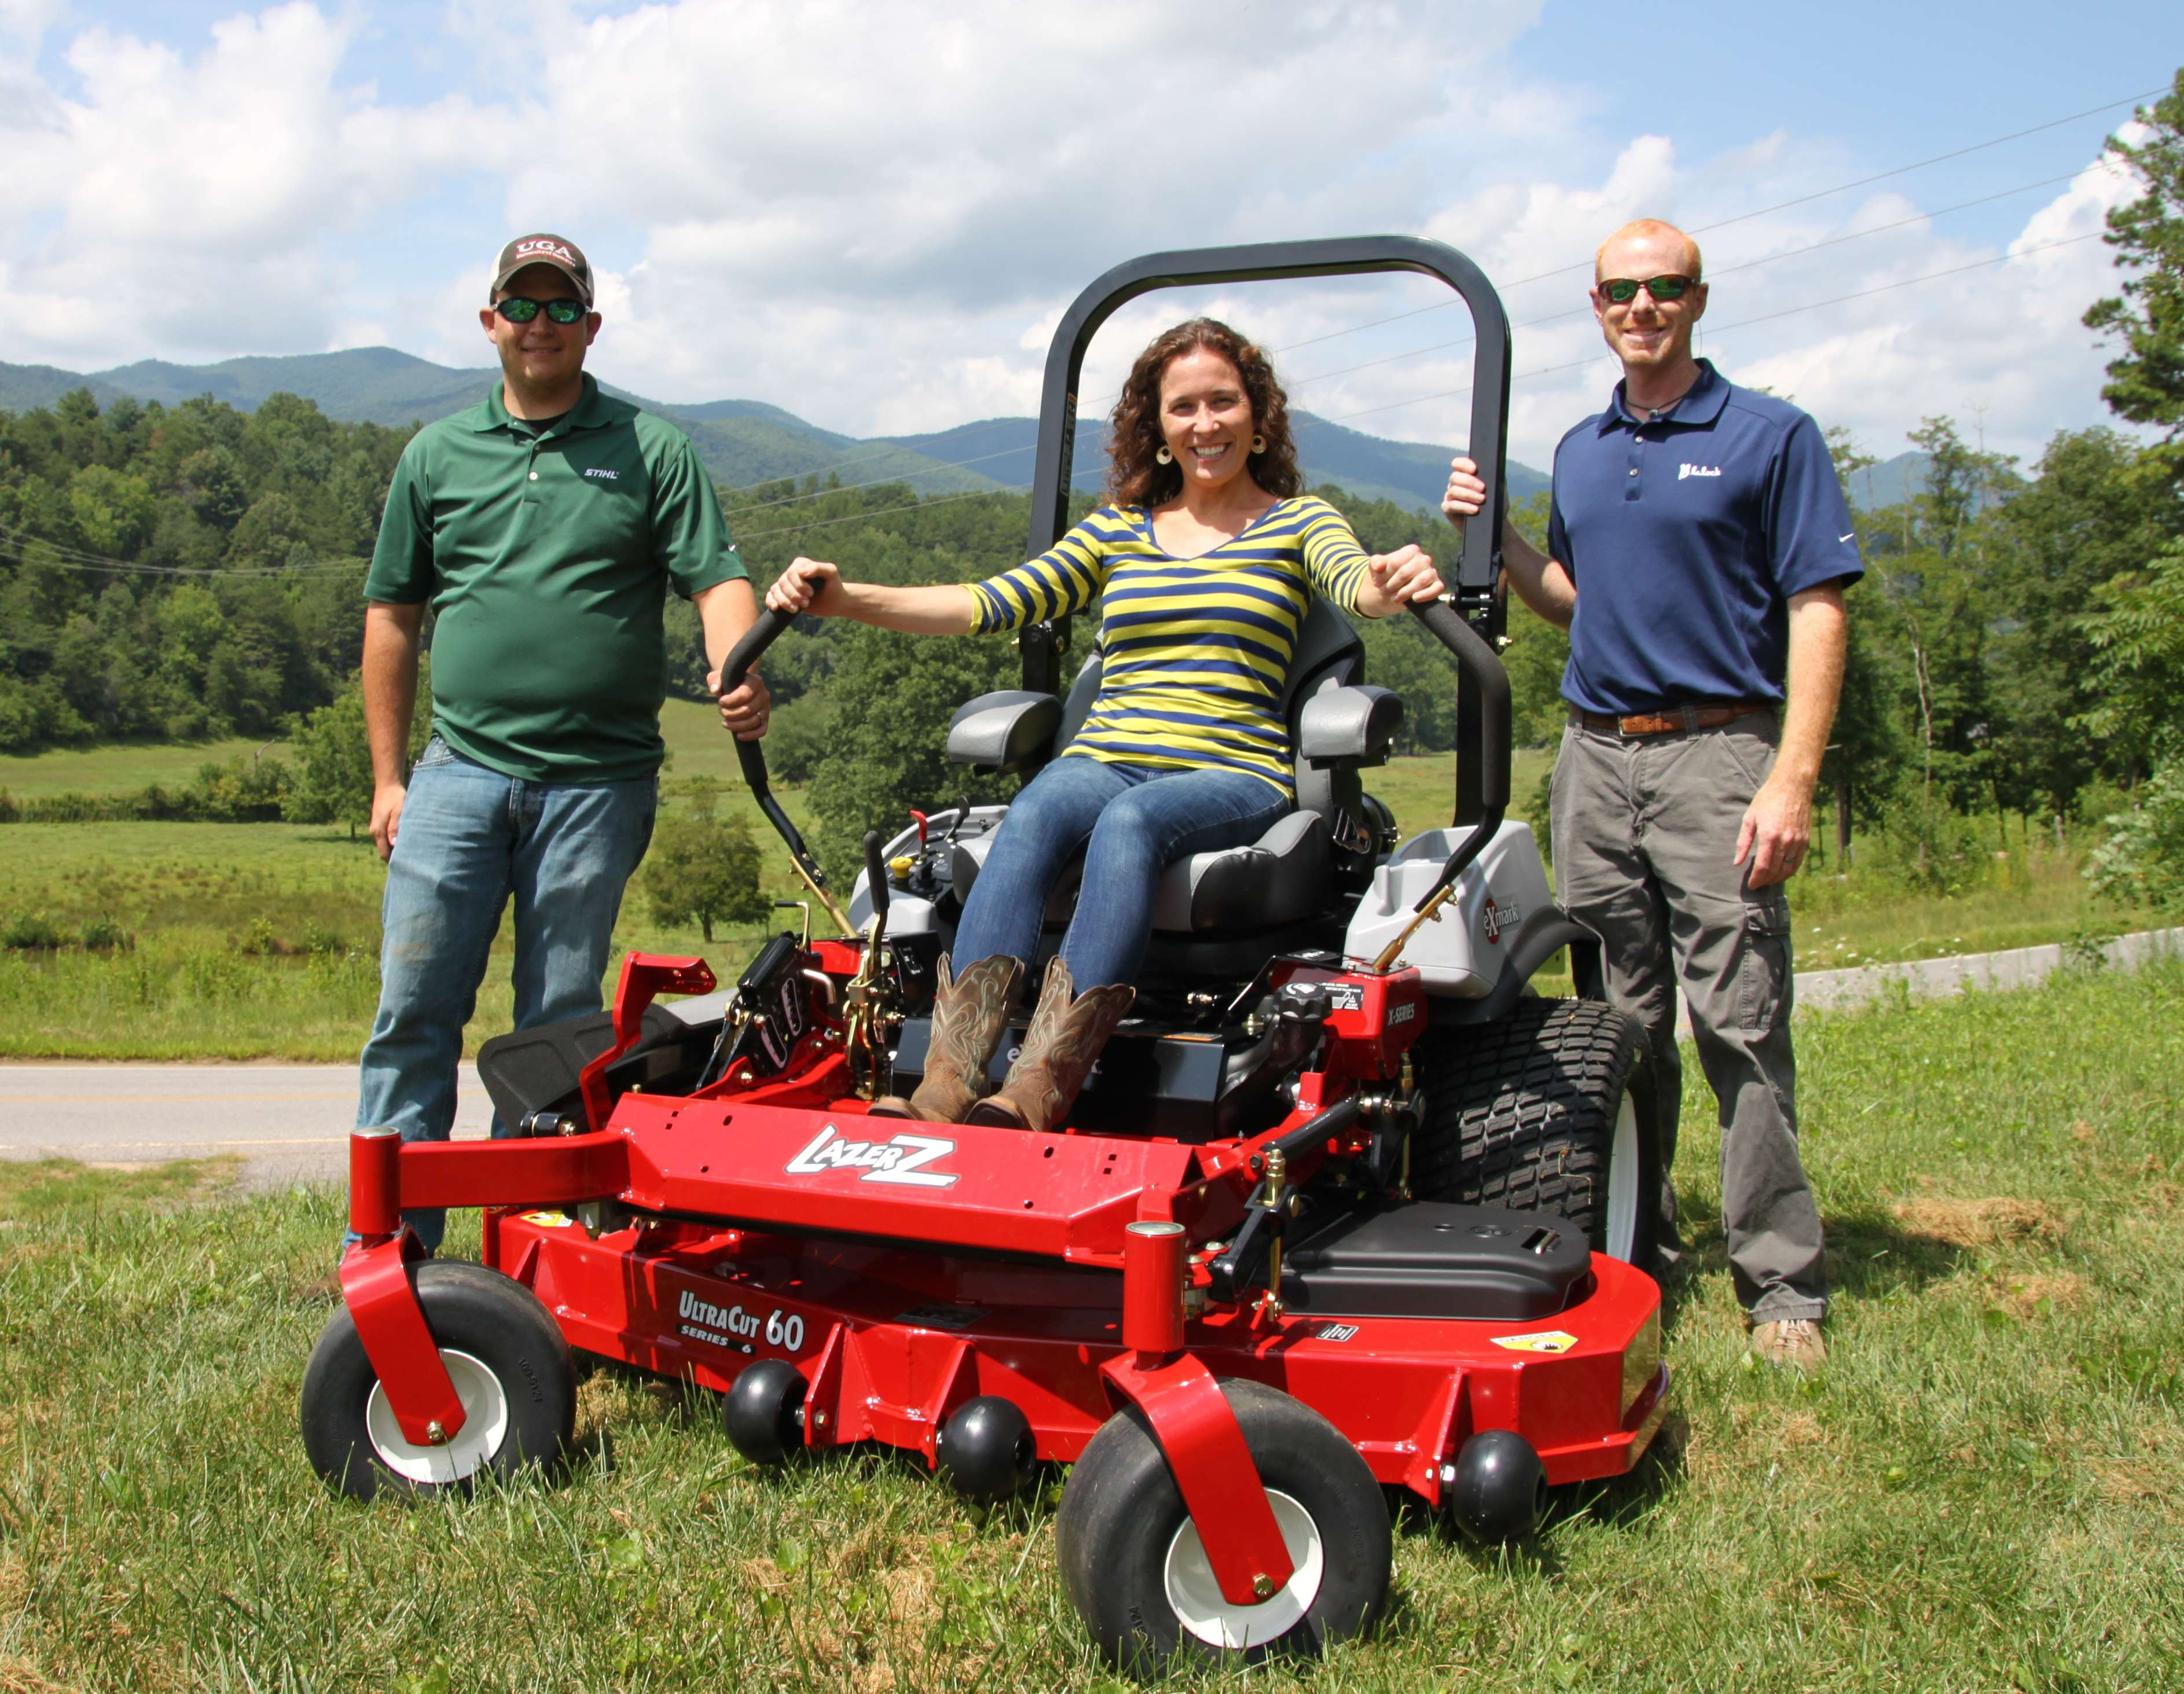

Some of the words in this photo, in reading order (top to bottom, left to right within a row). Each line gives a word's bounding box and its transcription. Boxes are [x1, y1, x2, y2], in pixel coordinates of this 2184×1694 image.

[516, 241, 574, 260] UGA
[584, 469, 618, 479] STIHL
[1388, 1002, 1415, 1026] X-SERIES
[681, 1325, 729, 1346] SERIES
[742, 1344, 752, 1354] 6
[765, 1309, 804, 1352] 60
